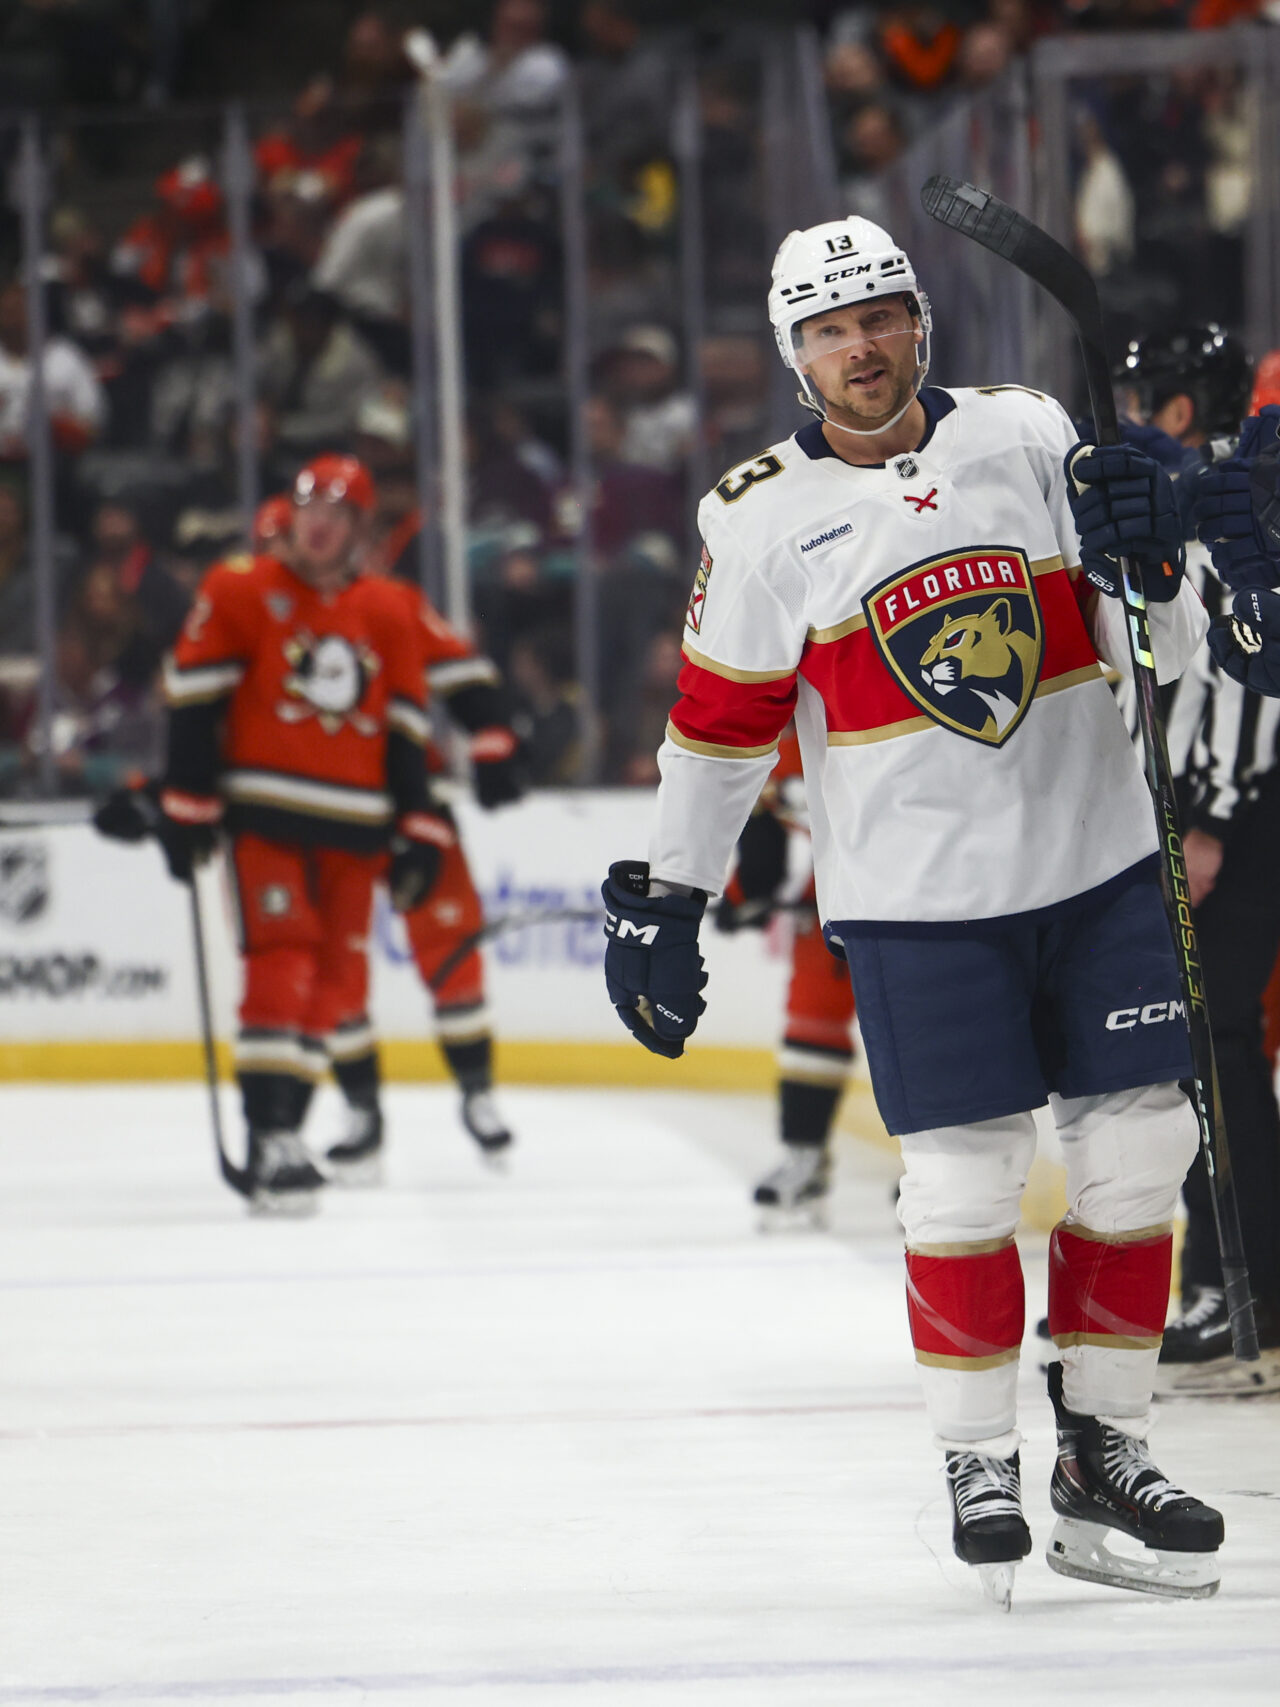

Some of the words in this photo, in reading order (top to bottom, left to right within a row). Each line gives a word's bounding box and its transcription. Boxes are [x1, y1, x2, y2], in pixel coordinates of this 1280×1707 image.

[825, 235, 853, 254] 13
[824, 264, 871, 283] CCM
[800, 522, 853, 554] AutoNation
[884, 561, 1016, 622] FLORIDA
[1087, 572, 1115, 593] CCM
[656, 1003, 684, 1025] CCM
